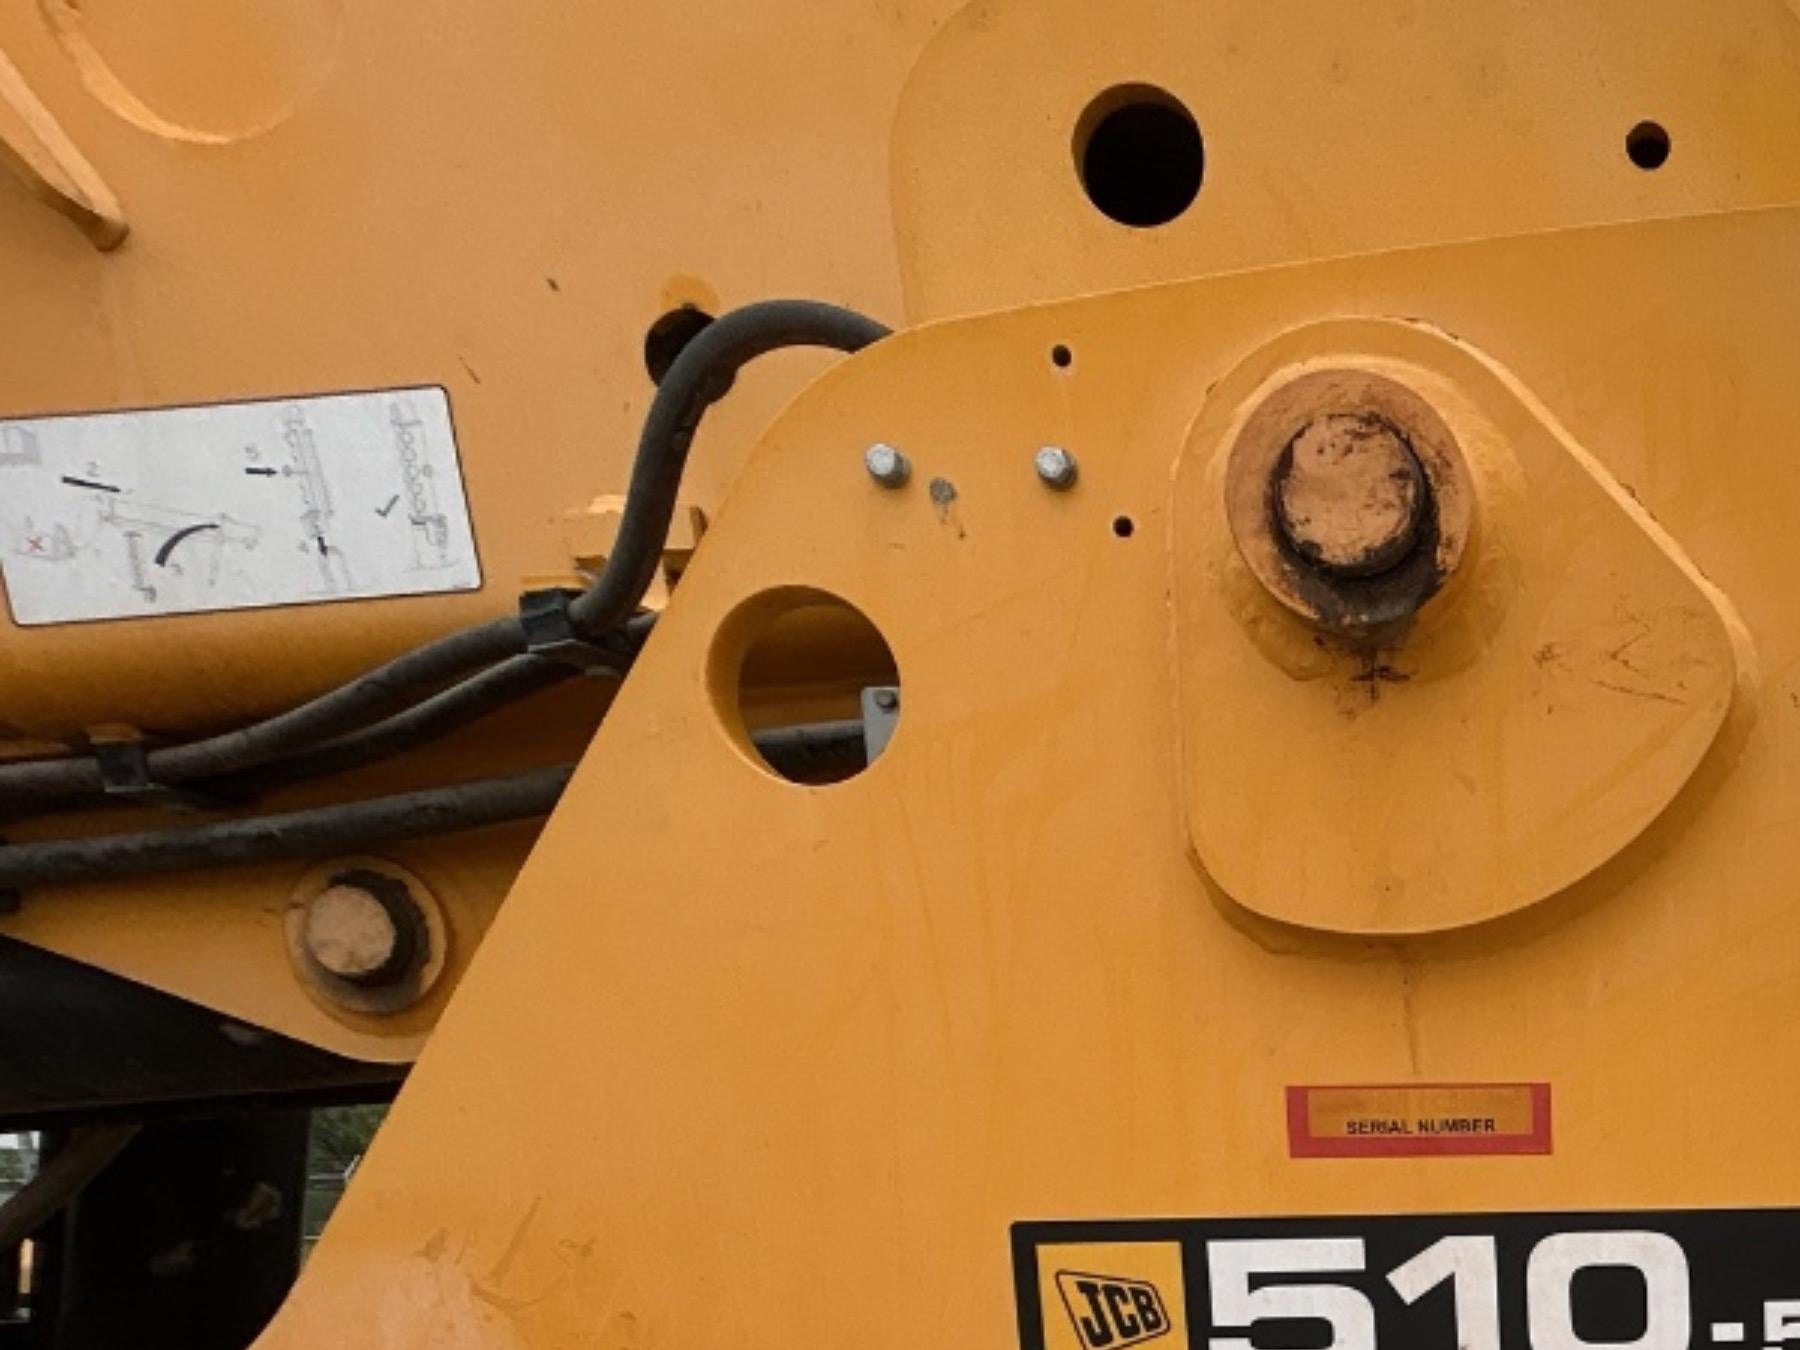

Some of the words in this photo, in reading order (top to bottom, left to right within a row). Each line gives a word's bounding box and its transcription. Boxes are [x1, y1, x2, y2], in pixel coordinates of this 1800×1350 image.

[1346, 1119, 1413, 1135] SERIAL
[1418, 1118, 1496, 1134] NUMBER
[1075, 1280, 1164, 1348] JCB
